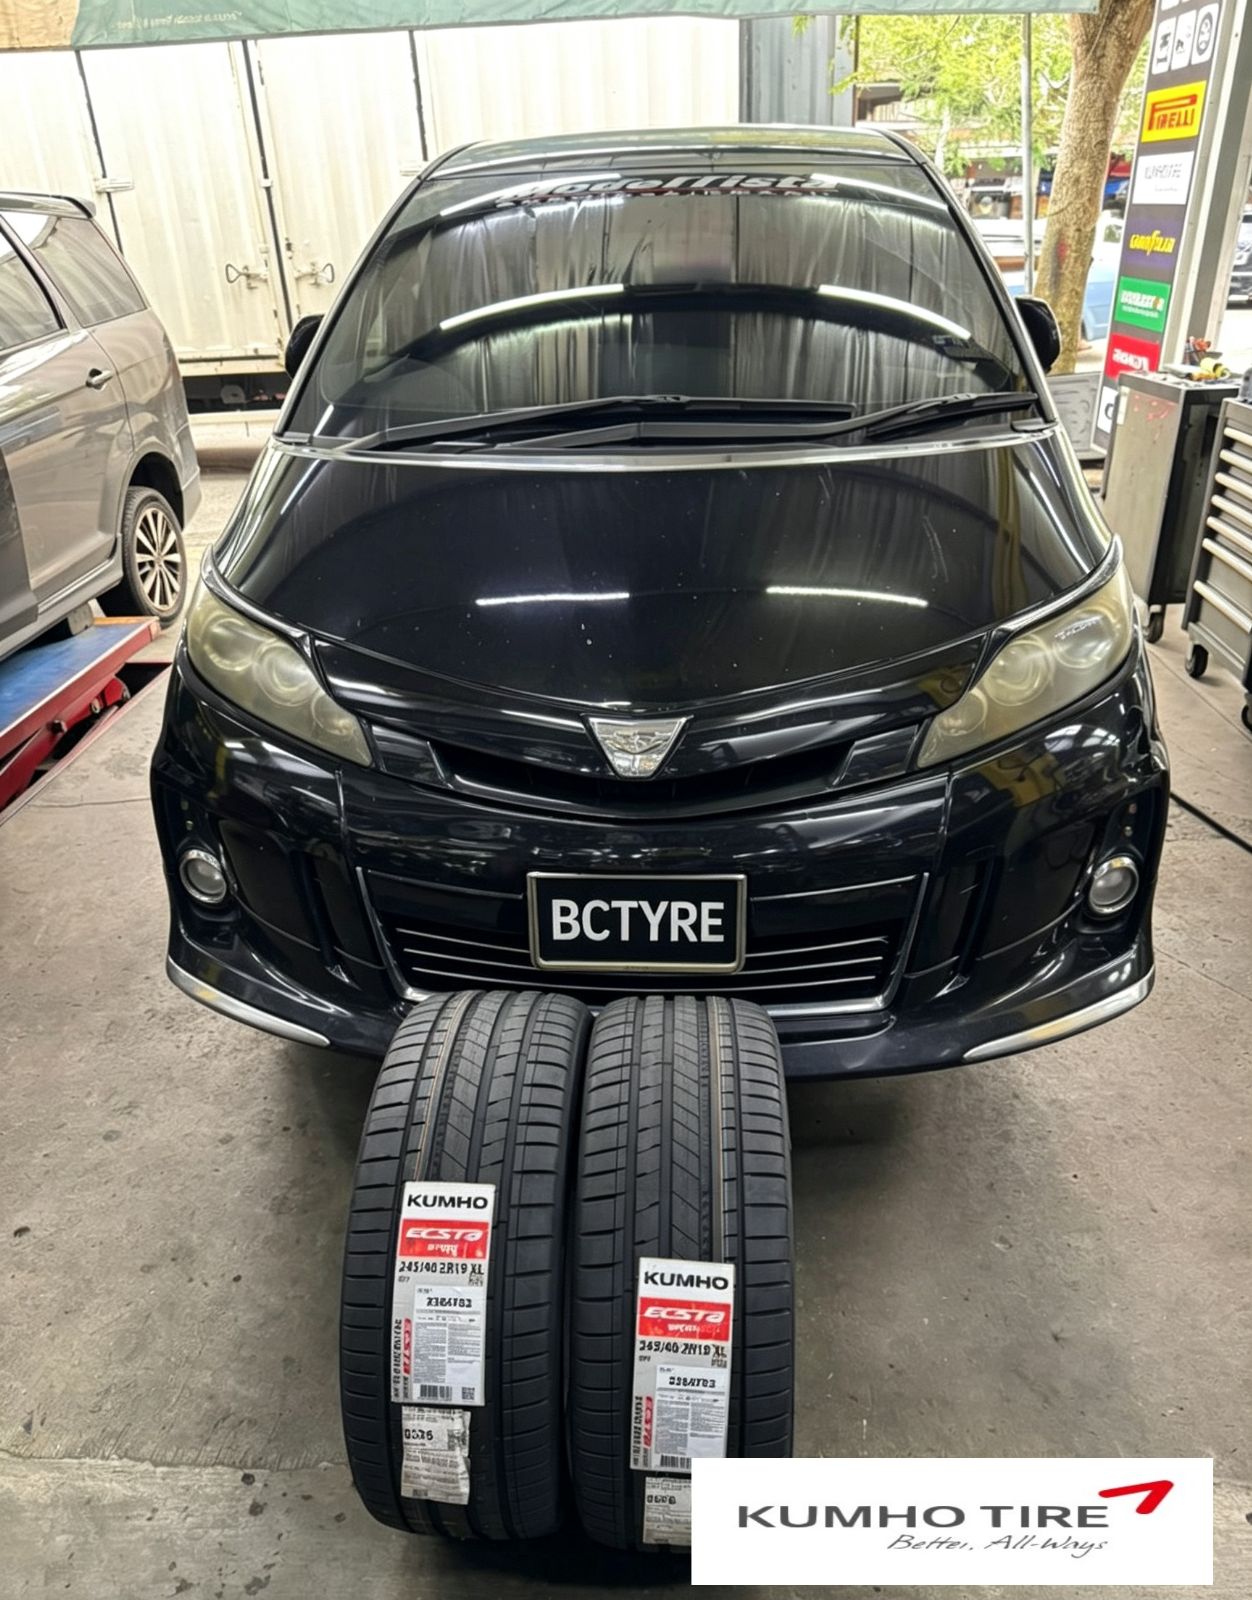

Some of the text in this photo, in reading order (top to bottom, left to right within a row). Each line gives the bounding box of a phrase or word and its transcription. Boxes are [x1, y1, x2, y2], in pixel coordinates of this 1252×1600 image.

[1147, 94, 1198, 131] PIRELLI
[551, 899, 725, 942] BCTYRE
[407, 1194, 488, 1209] KUMHO
[644, 1271, 729, 1290] KUMHO
